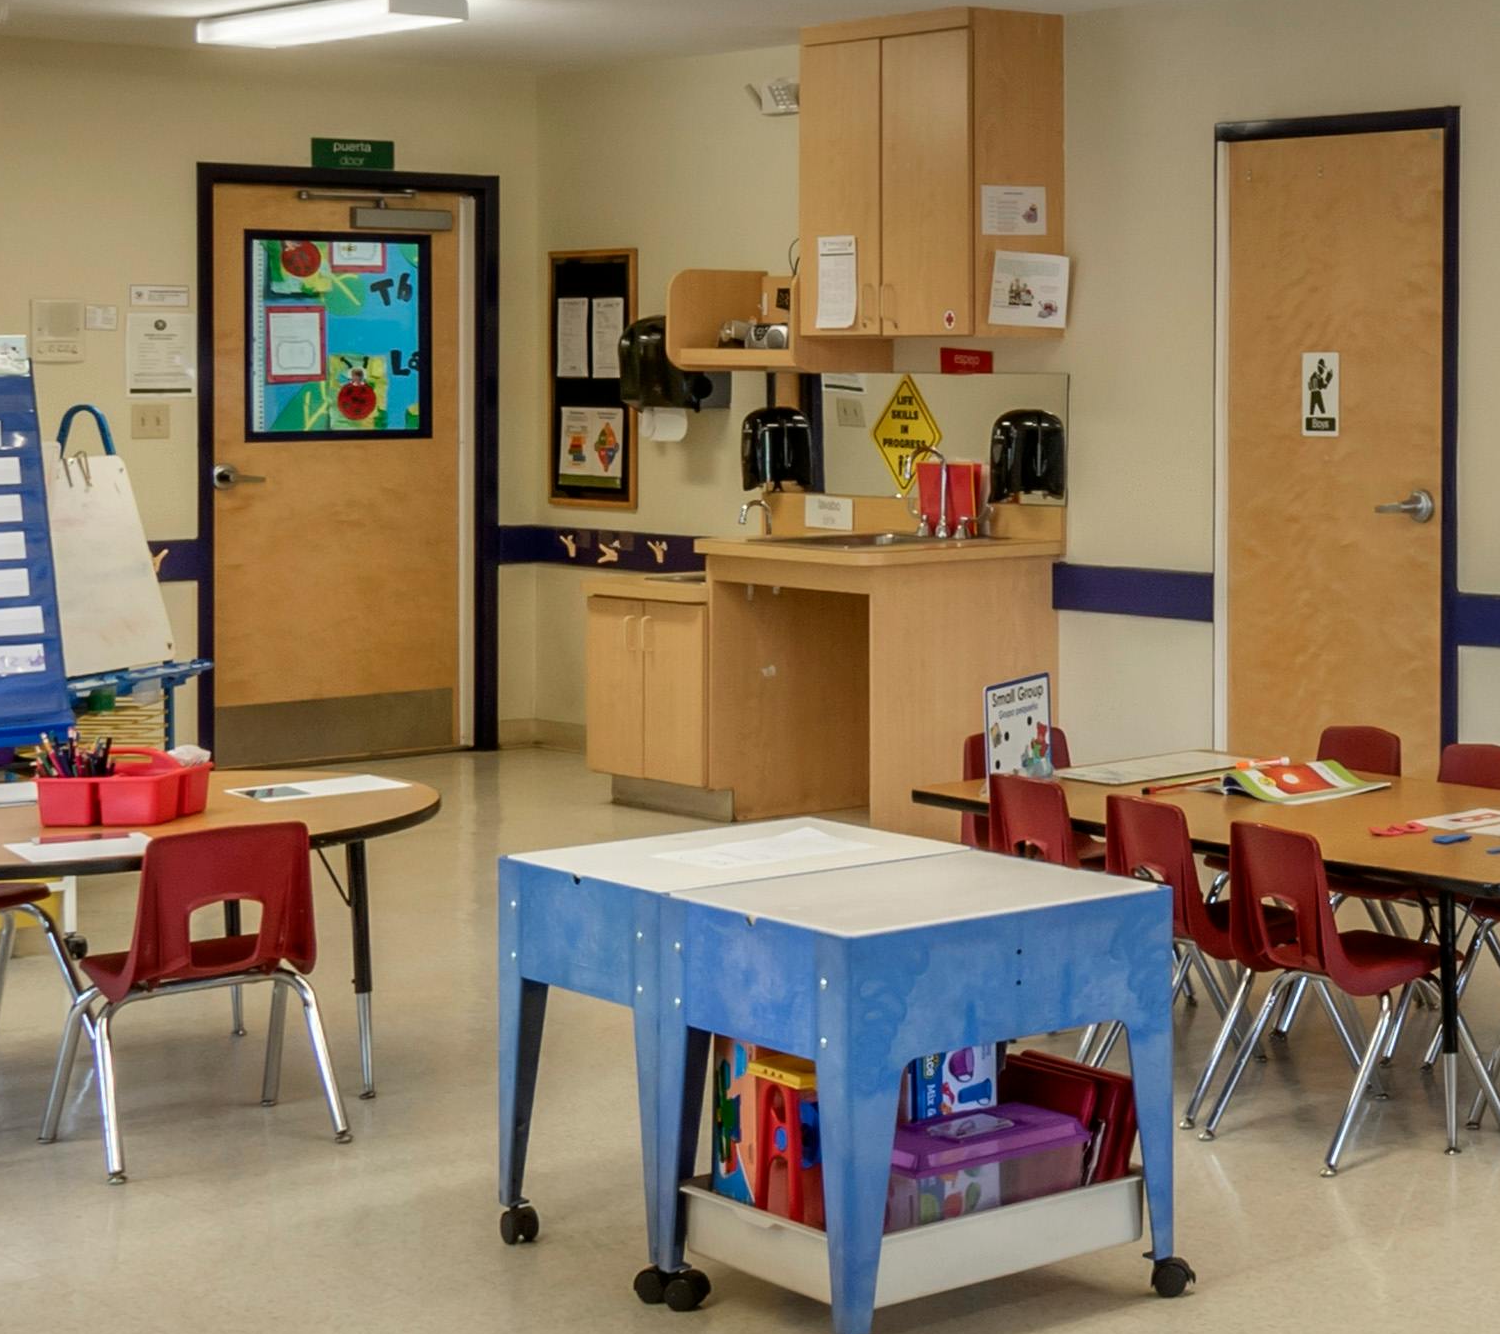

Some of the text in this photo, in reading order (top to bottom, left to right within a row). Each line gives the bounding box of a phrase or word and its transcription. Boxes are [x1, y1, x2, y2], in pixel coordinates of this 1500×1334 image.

[333, 141, 372, 154] puerta
[897, 395, 914, 406] LIFE
[891, 410, 919, 420] SKILLS
[900, 424, 909, 435] IN
[1311, 418, 1329, 431] Boys
[992, 685, 1044, 708] Small Group
